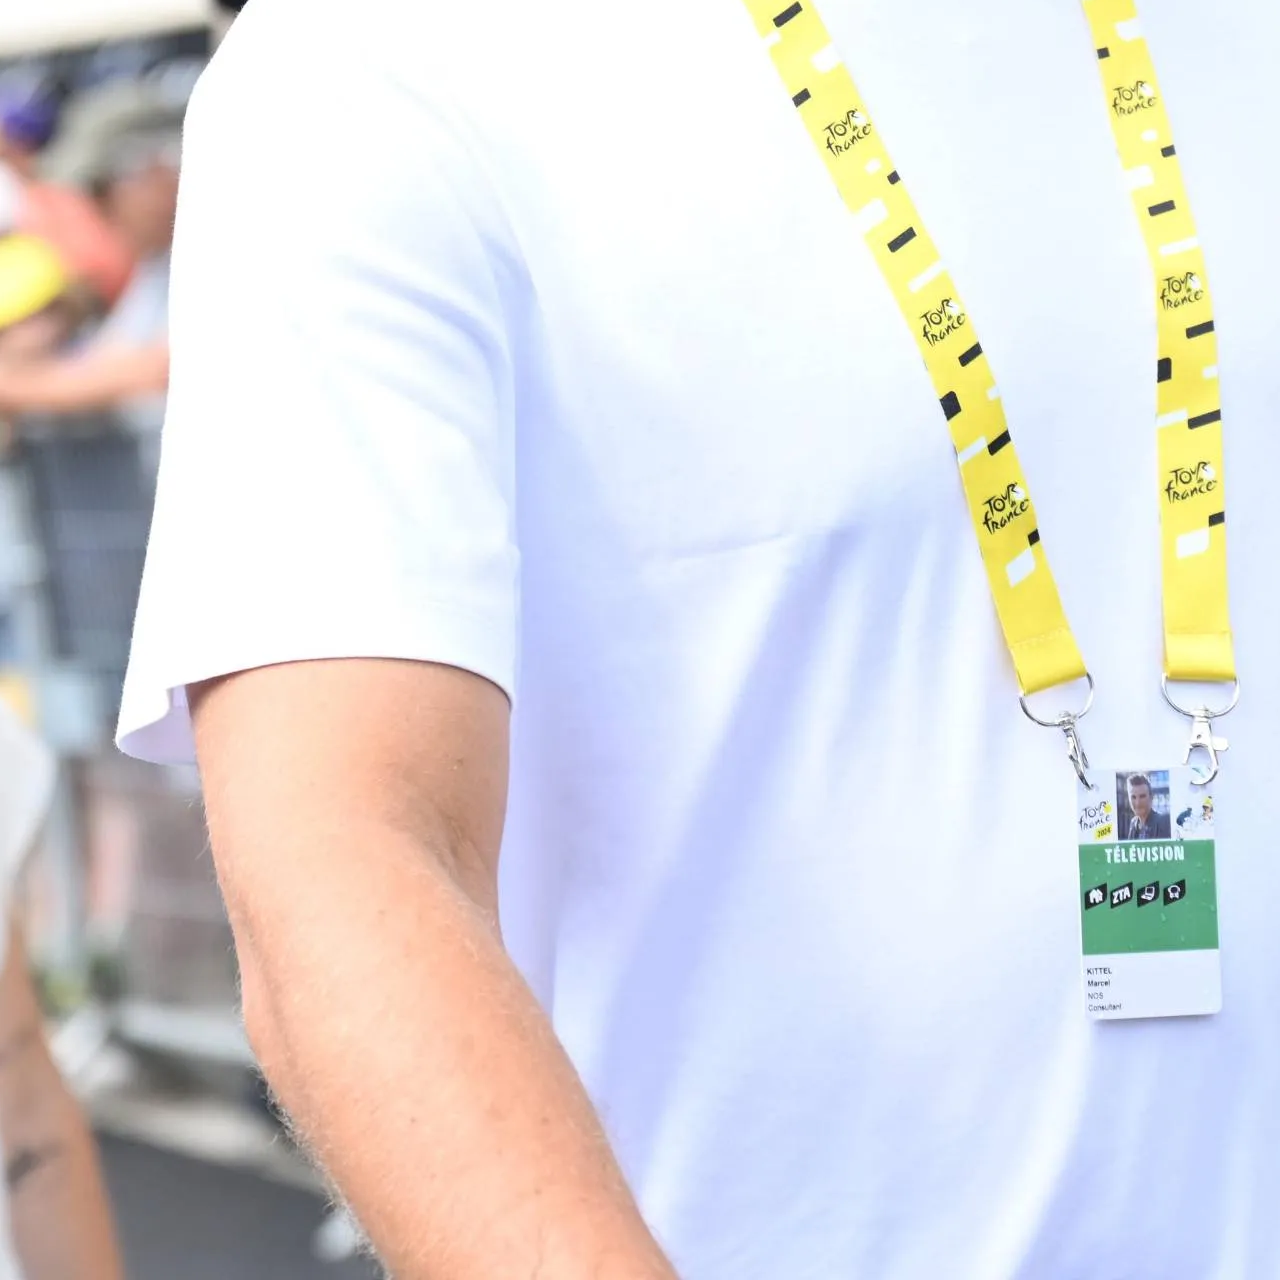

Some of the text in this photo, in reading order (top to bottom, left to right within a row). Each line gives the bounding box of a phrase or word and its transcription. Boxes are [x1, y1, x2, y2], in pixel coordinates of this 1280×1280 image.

[1104, 844, 1185, 864] TÉLÉVISION
[1112, 886, 1131, 905] ZTA
[1086, 967, 1113, 975] KITTEL
